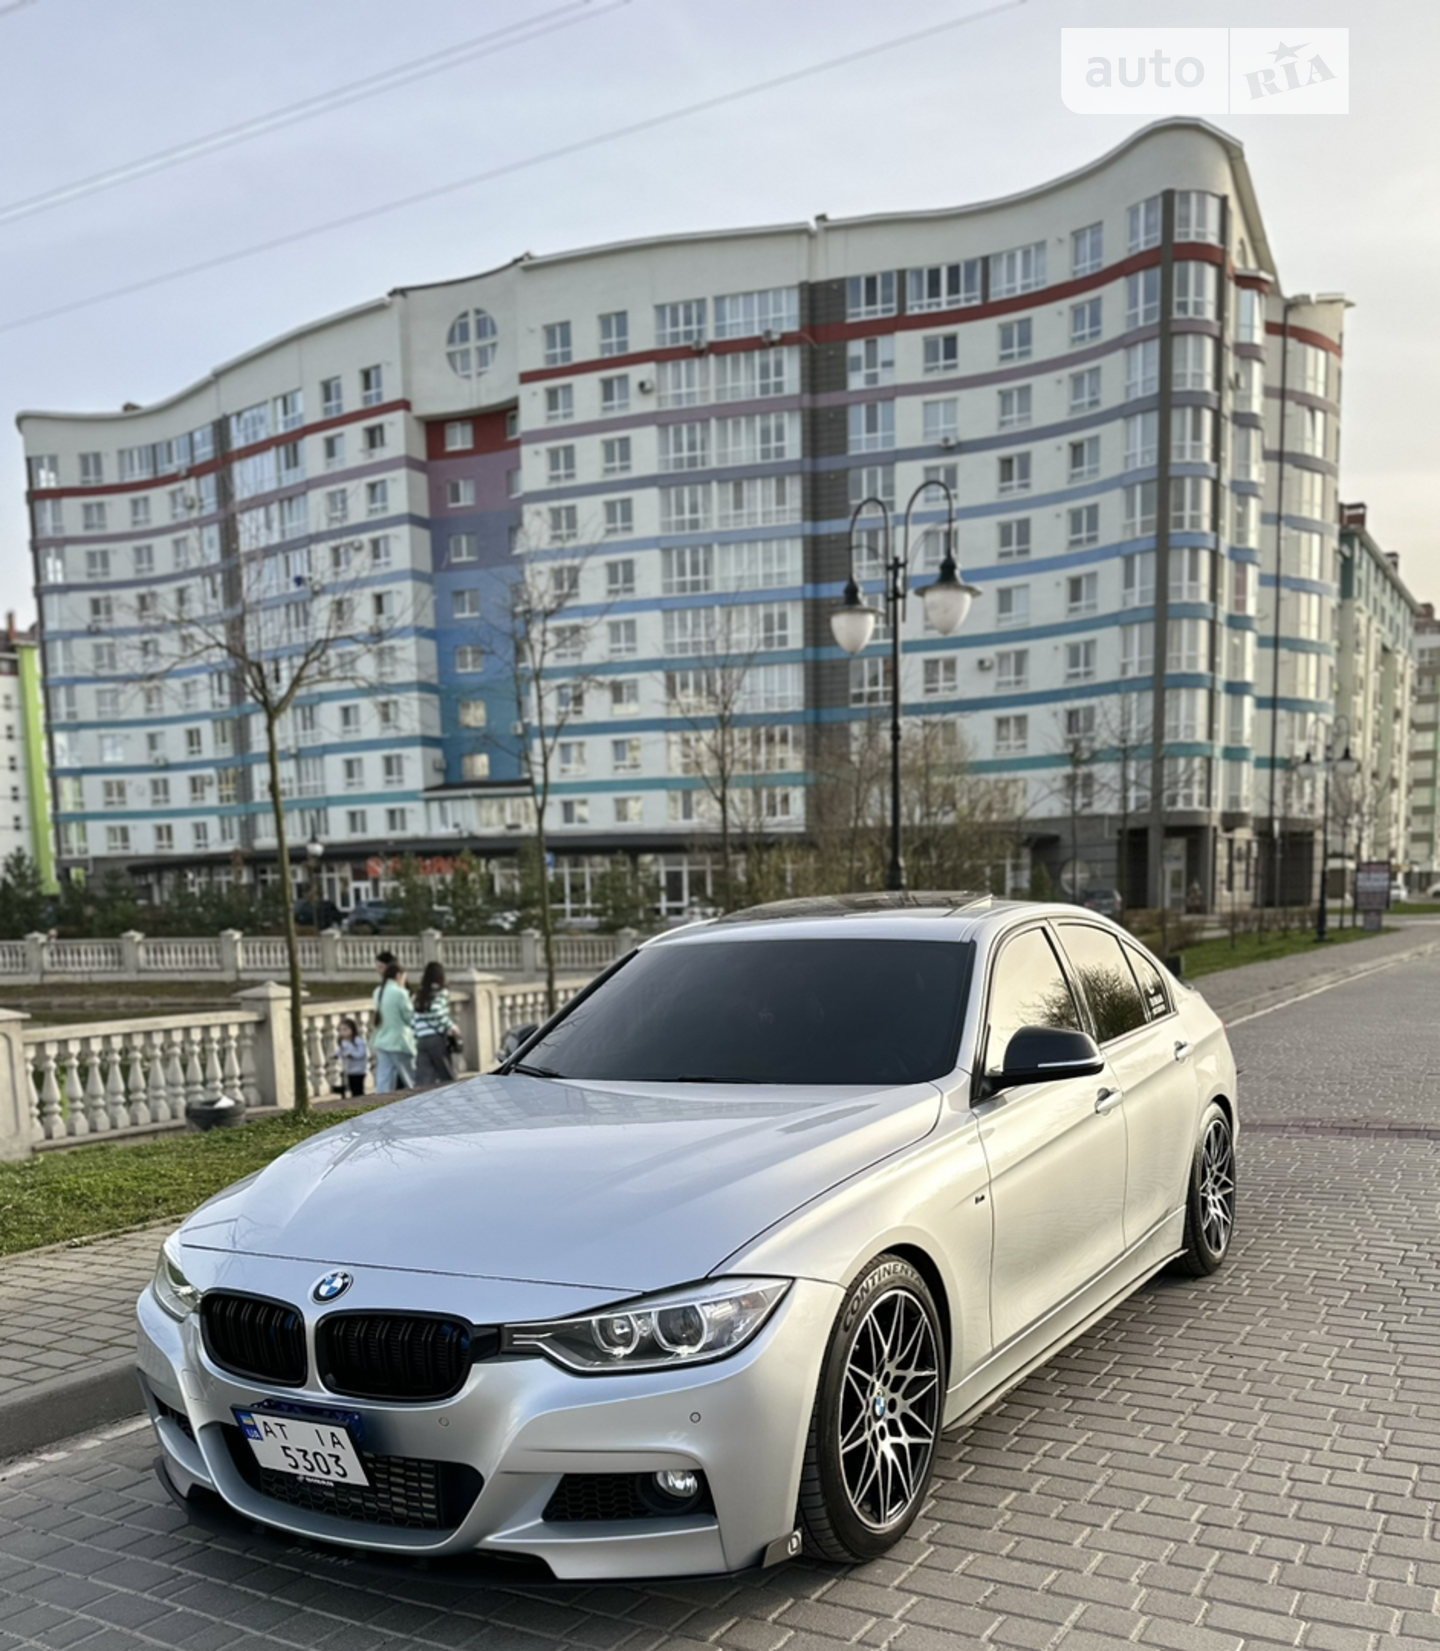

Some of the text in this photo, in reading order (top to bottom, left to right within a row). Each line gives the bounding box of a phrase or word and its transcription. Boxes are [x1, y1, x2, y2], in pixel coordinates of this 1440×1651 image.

[245, 1428, 261, 1439] UA
[262, 1421, 346, 1451] AT IA
[280, 1445, 348, 1479] 5303
[285, 1546, 355, 1567] DINAN
